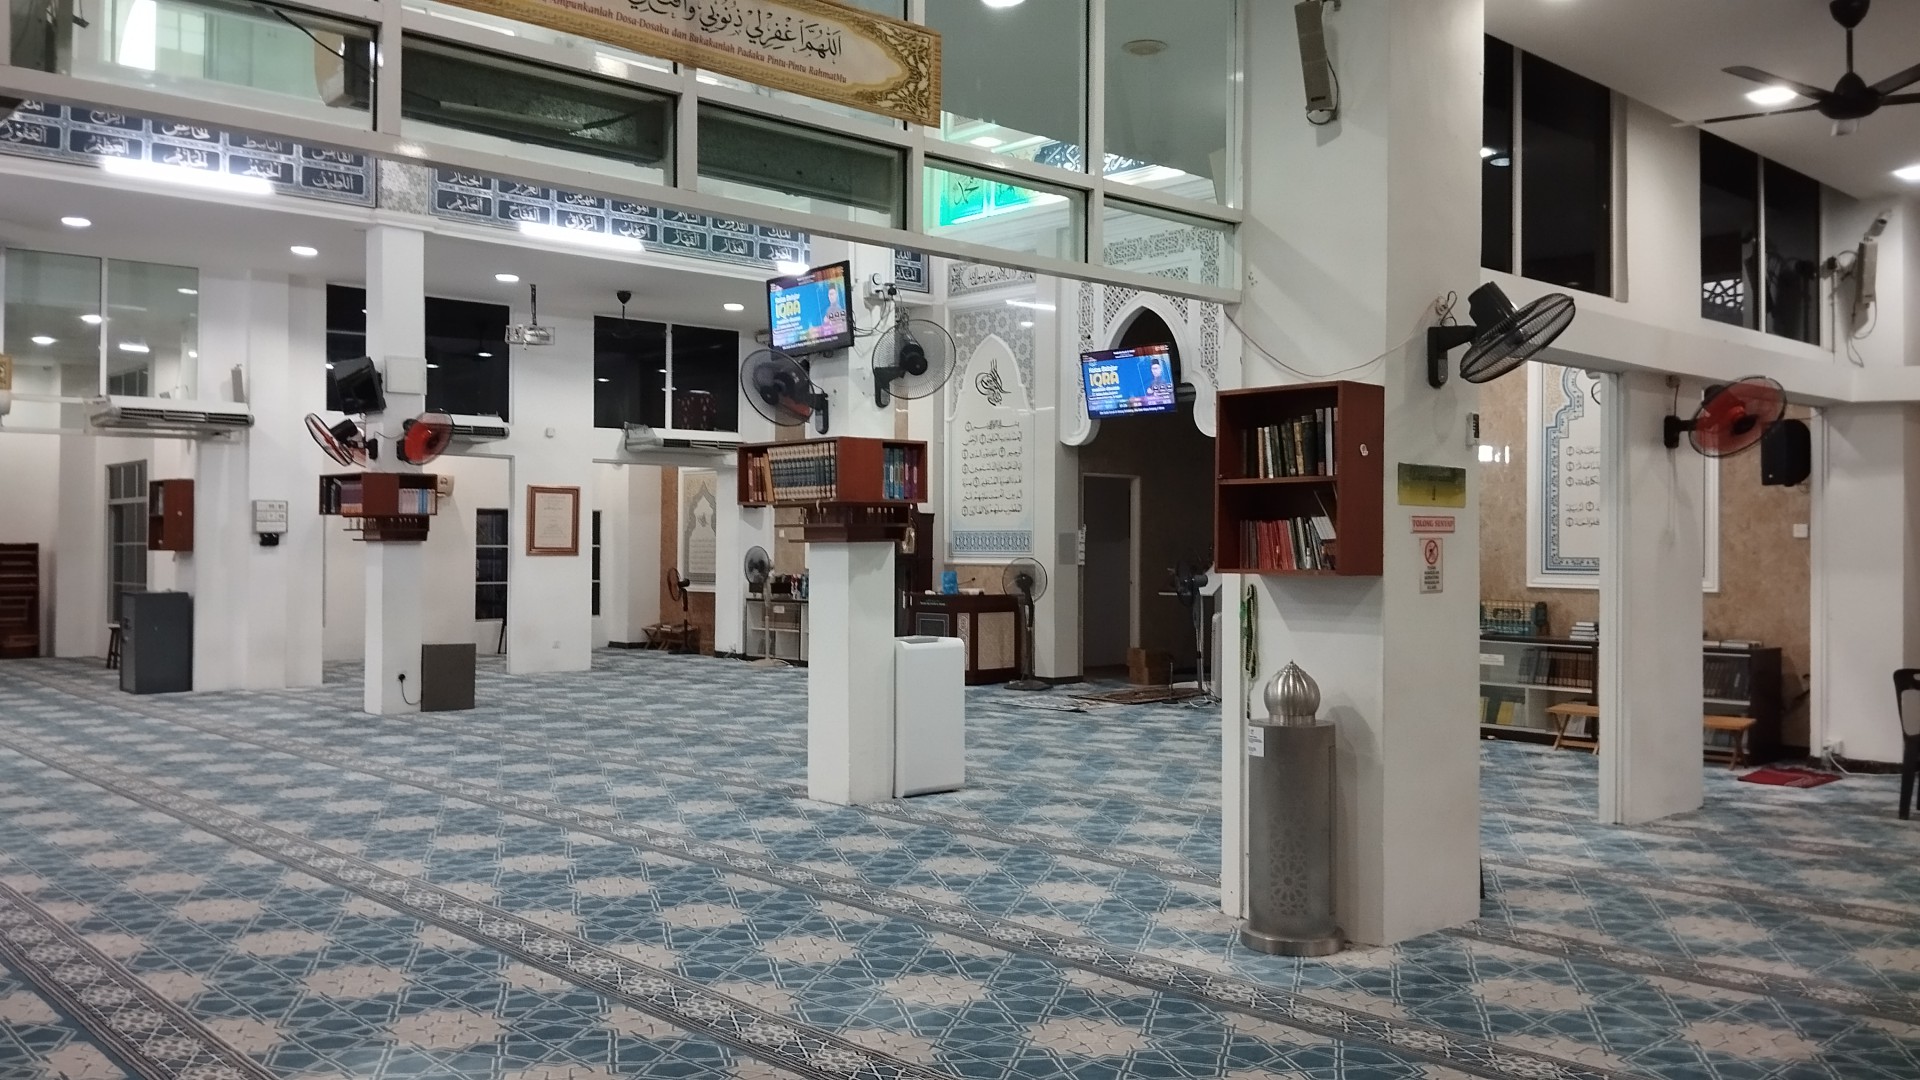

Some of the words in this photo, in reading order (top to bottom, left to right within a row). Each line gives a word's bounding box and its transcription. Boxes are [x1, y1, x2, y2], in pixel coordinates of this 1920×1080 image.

[616, 11, 670, 35] Dosa-Dosaku
[671, 28, 688, 40] dan
[688, 32, 736, 55] Bukakanlah
[737, 46, 766, 63] Padaku
[767, 54, 807, 74] Pintu-Pintu
[808, 65, 848, 84] RahmatMu
[1089, 371, 1120, 387] IQRA
